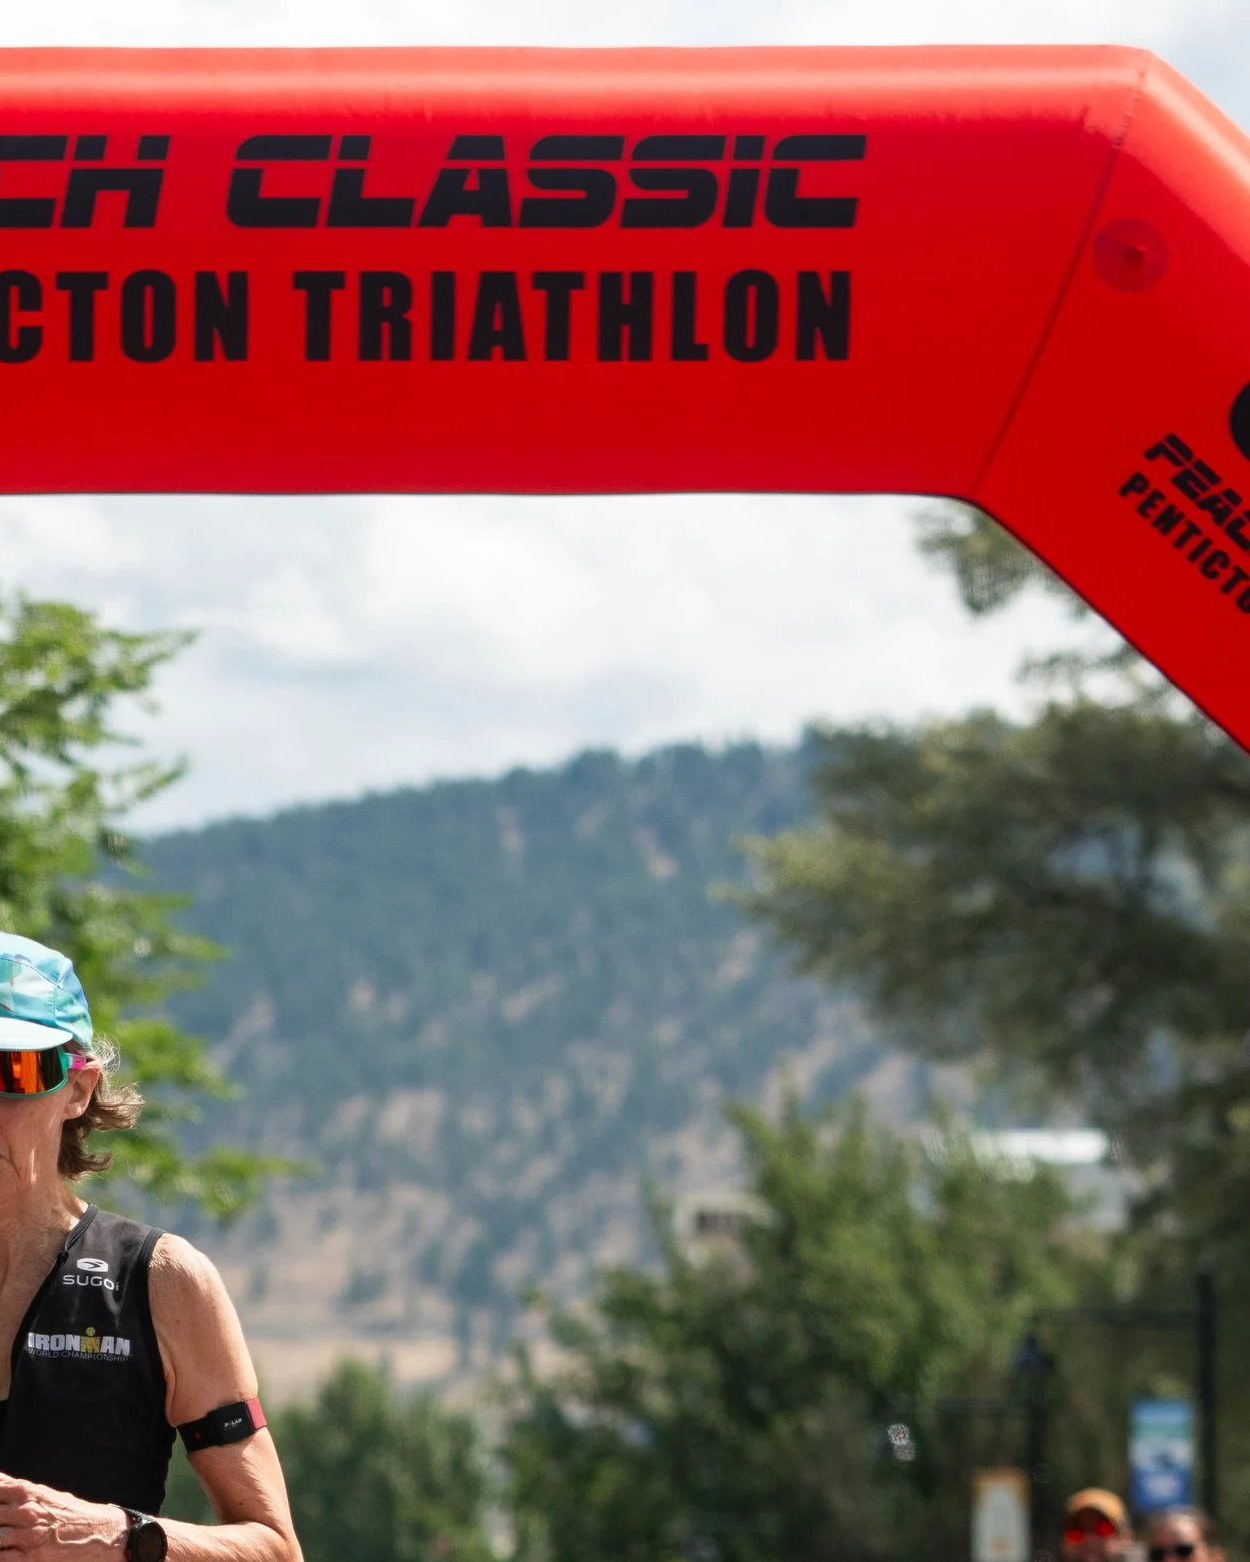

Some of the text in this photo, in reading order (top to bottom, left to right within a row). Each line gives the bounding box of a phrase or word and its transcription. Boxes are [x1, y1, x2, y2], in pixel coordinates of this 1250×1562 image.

[225, 134, 868, 229] CLASSIC
[292, 268, 851, 363] TRIATHLON
[28, 1327, 131, 1357] IRONMAN
[28, 1347, 129, 1363] WORLD CHAMPIONSHIP
